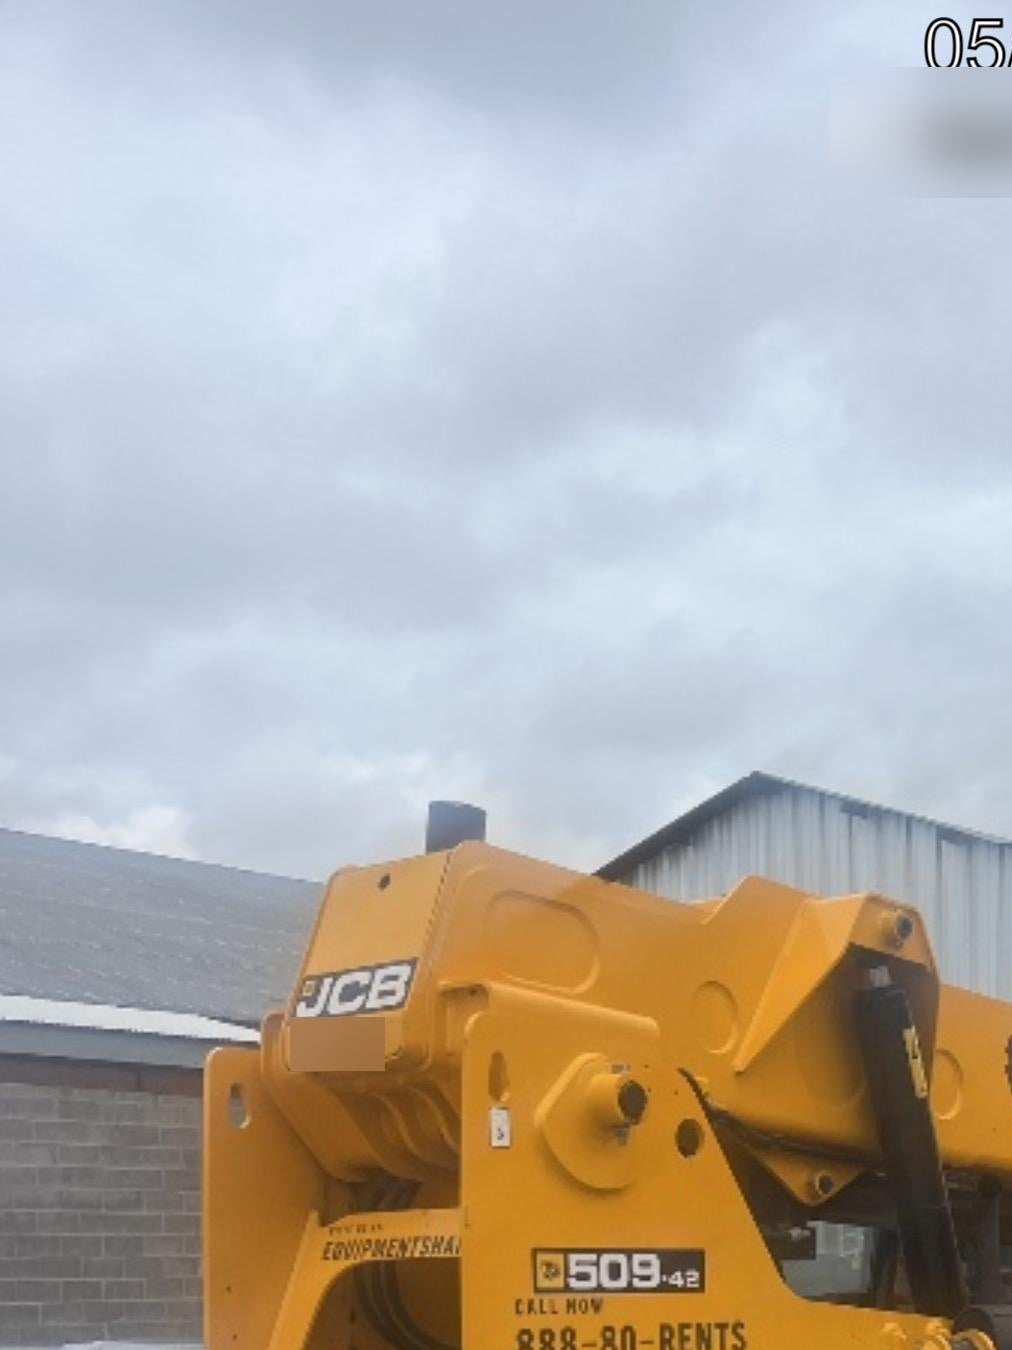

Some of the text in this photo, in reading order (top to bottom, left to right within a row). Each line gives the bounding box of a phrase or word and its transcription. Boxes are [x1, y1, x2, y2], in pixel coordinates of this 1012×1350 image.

[296, 964, 412, 1017] JCB
[322, 1235, 462, 1261] EQUIPMENTSHA
[514, 1299, 604, 1315] CALL NOW
